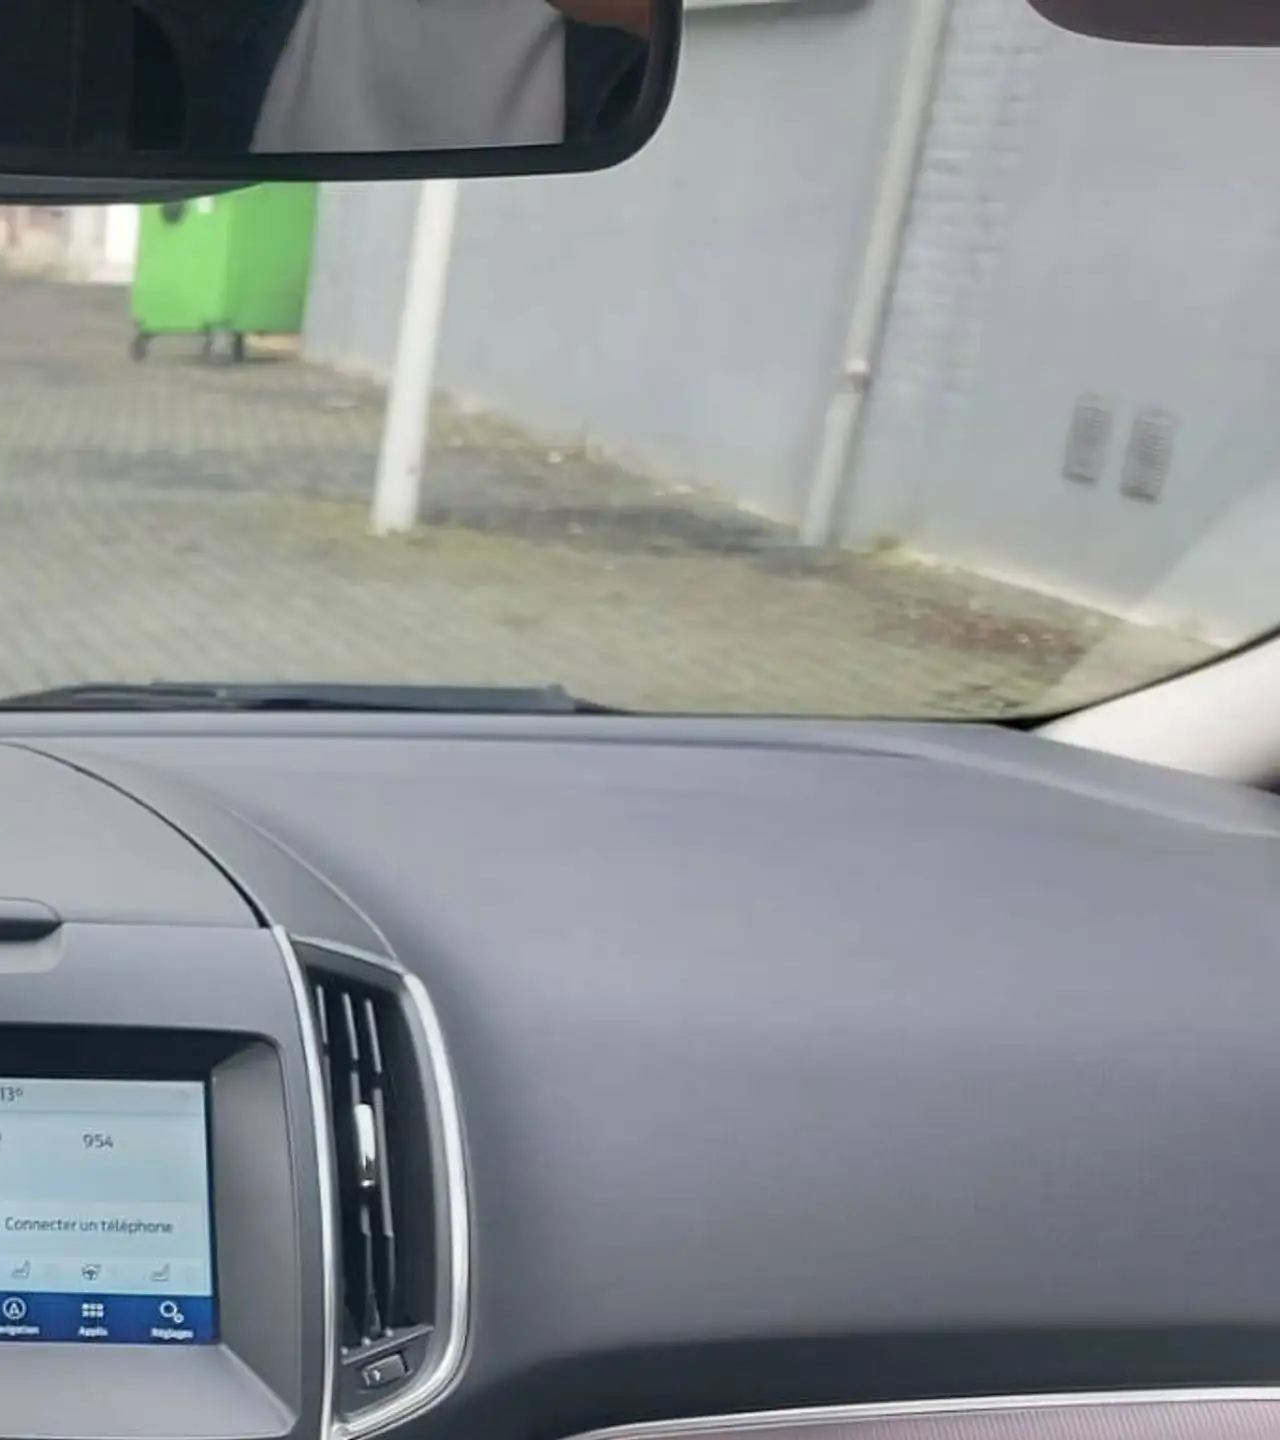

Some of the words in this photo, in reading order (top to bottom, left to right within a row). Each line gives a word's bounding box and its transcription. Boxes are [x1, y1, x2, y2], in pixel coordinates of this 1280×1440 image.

[82, 1133, 114, 1149] 954
[4, 1215, 76, 1233] Connecter
[79, 1220, 98, 1233] un
[100, 1219, 174, 1237] téléphone
